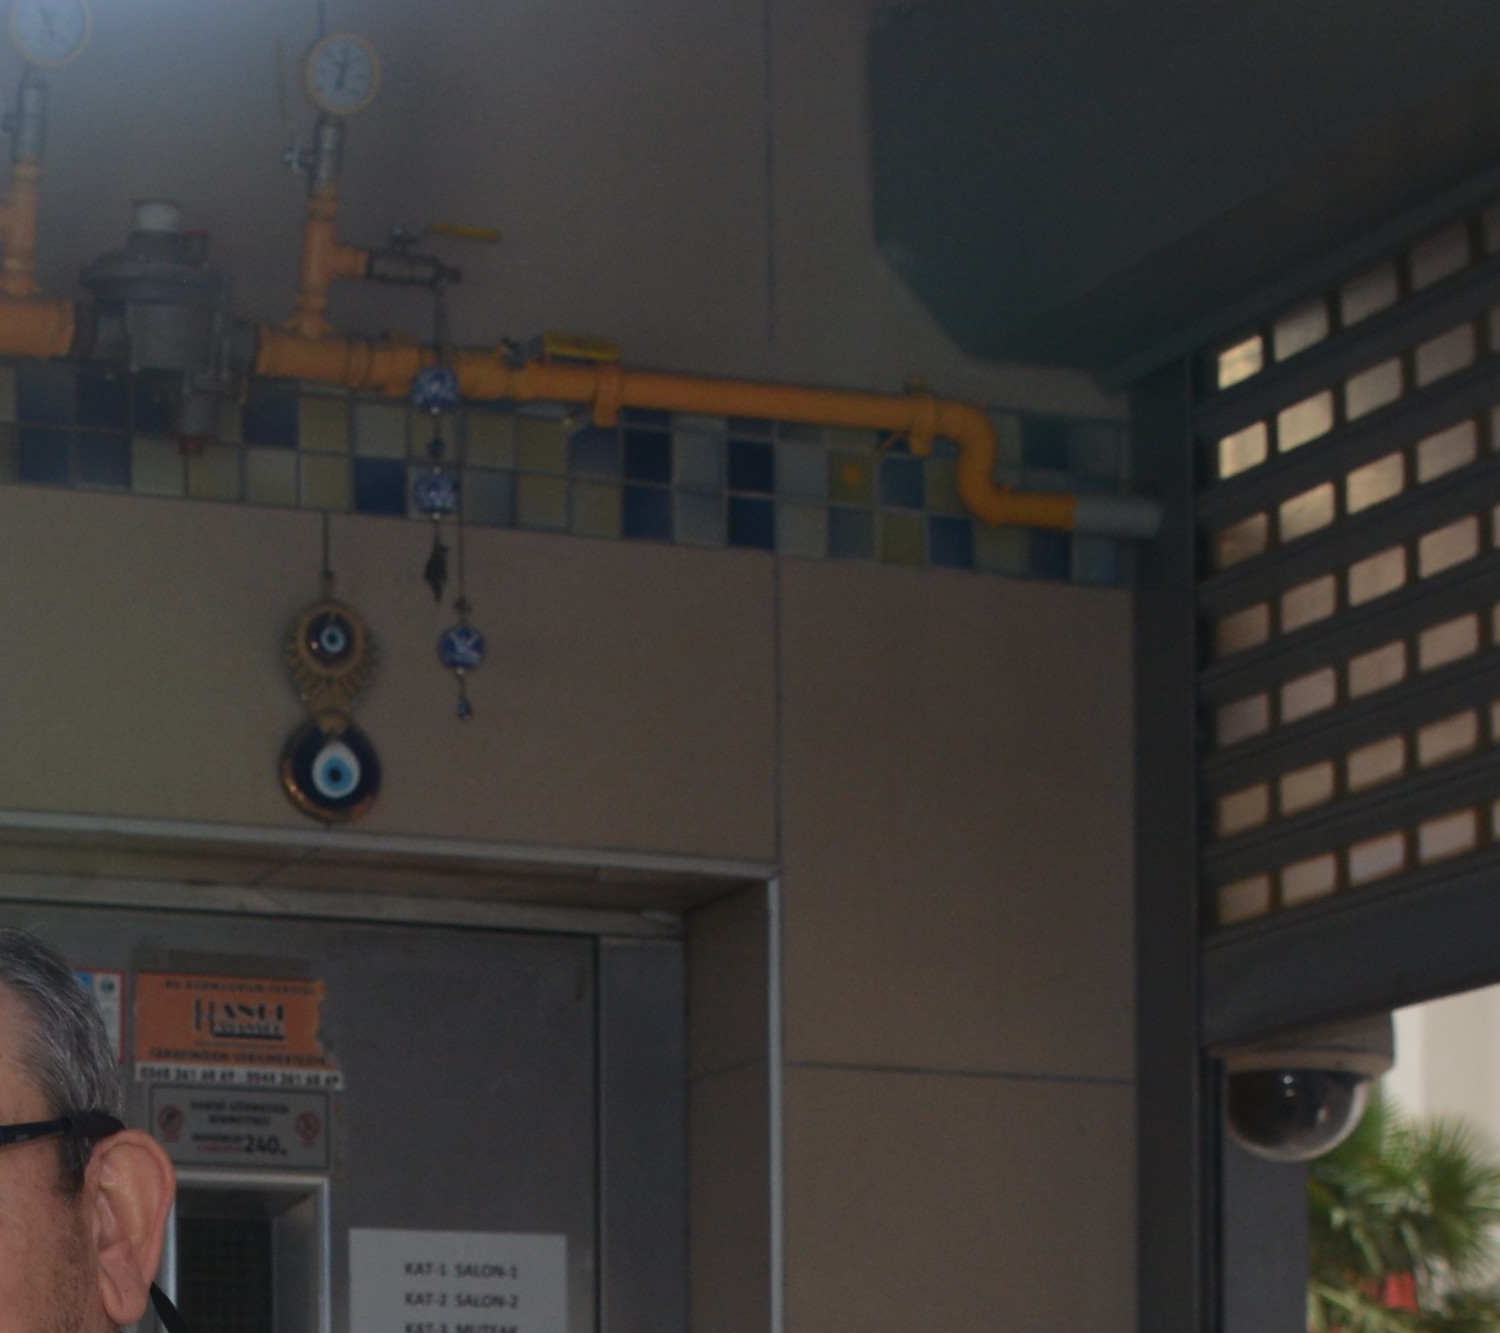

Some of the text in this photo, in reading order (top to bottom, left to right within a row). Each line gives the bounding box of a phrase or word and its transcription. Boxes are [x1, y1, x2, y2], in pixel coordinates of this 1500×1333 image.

[405, 1262, 518, 1279] KAT-1 SALON-1
[405, 1292, 518, 1309] KAT-2 SALON-2
